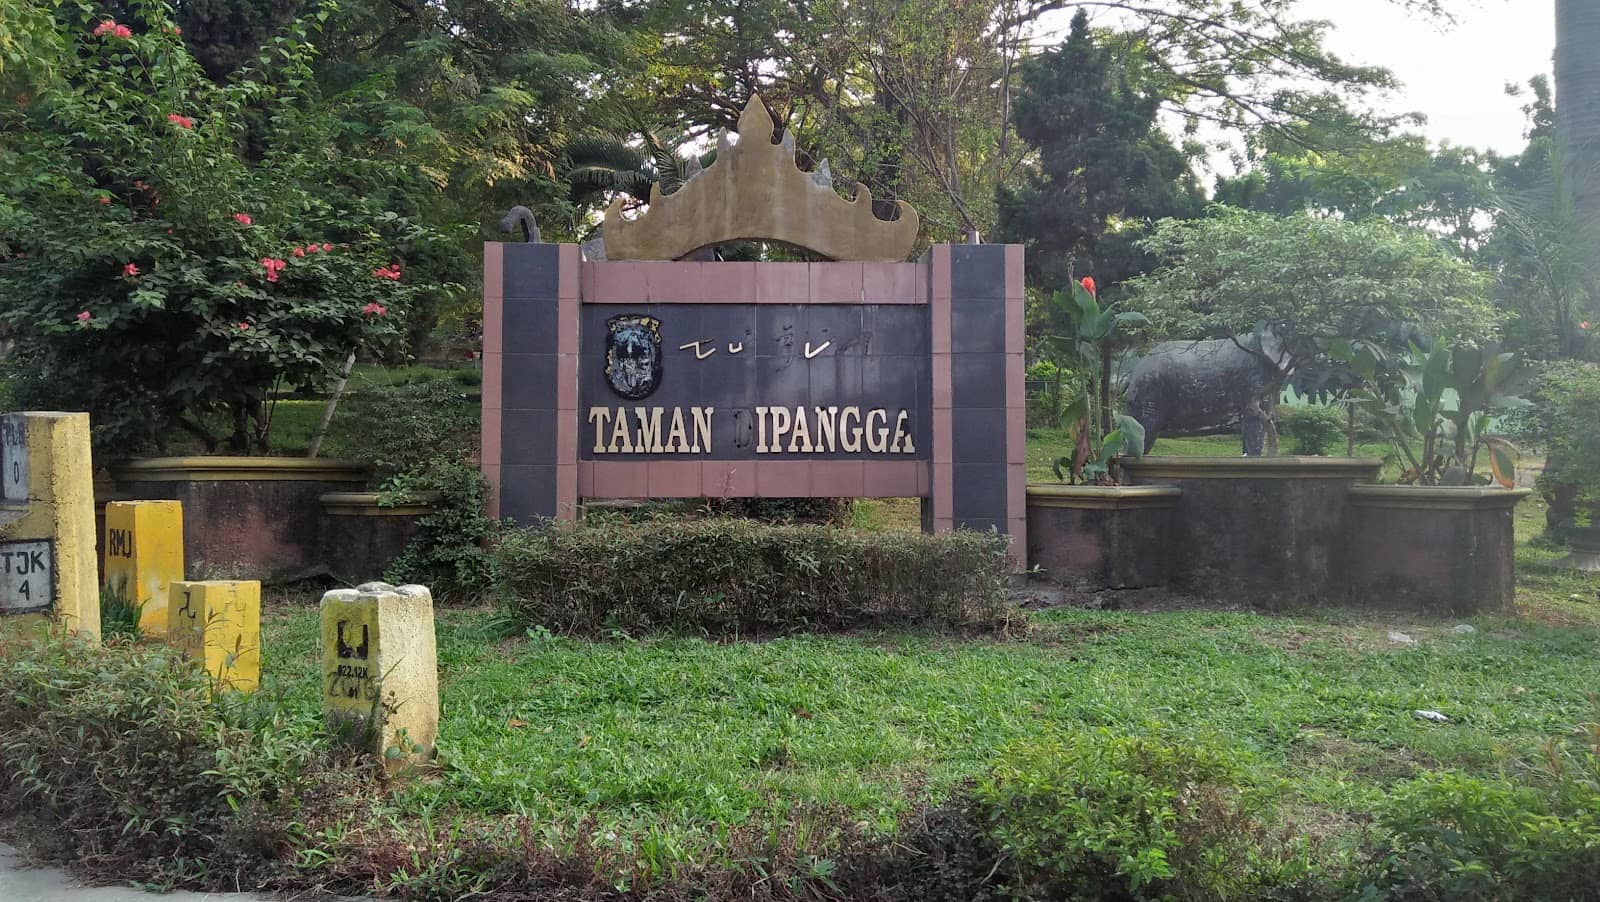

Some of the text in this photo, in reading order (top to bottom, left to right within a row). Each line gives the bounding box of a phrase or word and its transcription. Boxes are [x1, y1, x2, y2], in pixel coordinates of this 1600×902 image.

[588, 406, 916, 454] TAMAN IPANGGA
[109, 528, 132, 559] RMJ
[1, 551, 46, 575] TJK
[18, 579, 30, 601] 4
